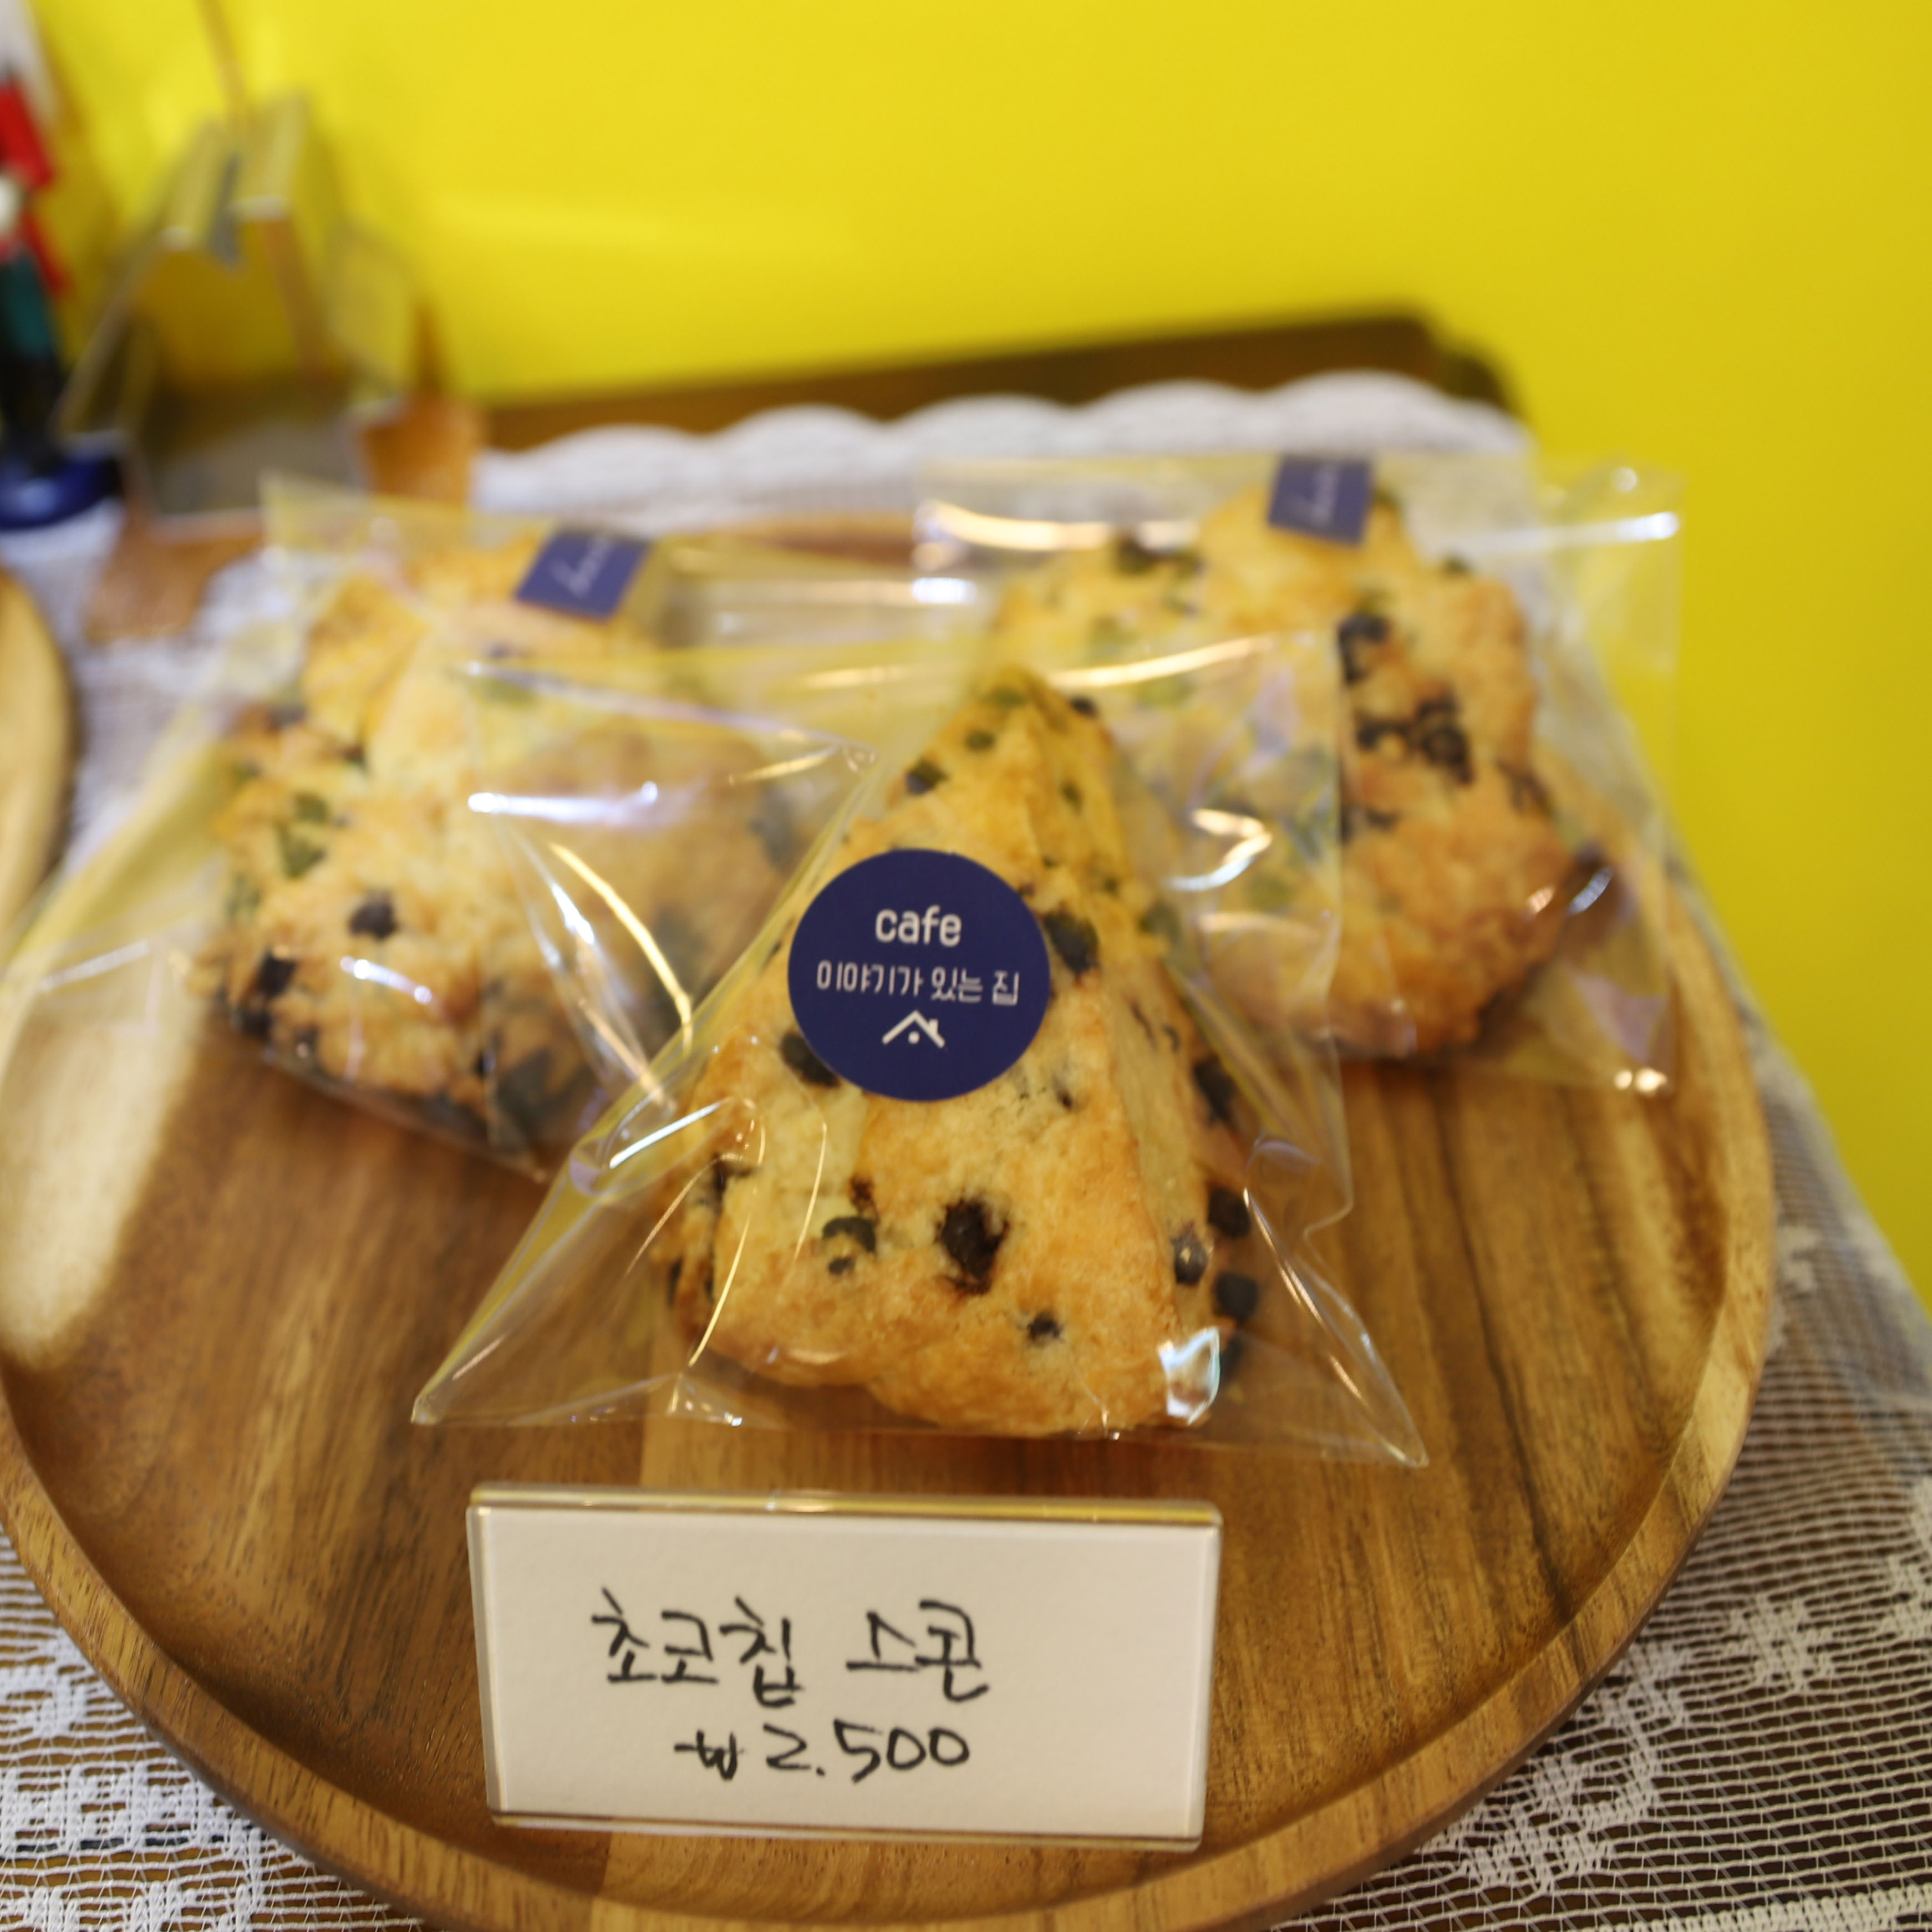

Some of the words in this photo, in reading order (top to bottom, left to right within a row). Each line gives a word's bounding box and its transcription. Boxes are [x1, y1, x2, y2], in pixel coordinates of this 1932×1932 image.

[875, 904, 963, 947] cafe
[816, 960, 924, 997] 이야기가
[931, 966, 983, 1003] 있는
[992, 971, 1020, 1006] 집
[591, 1587, 804, 1708] 초코칩
[846, 1599, 990, 1702] 스콘
